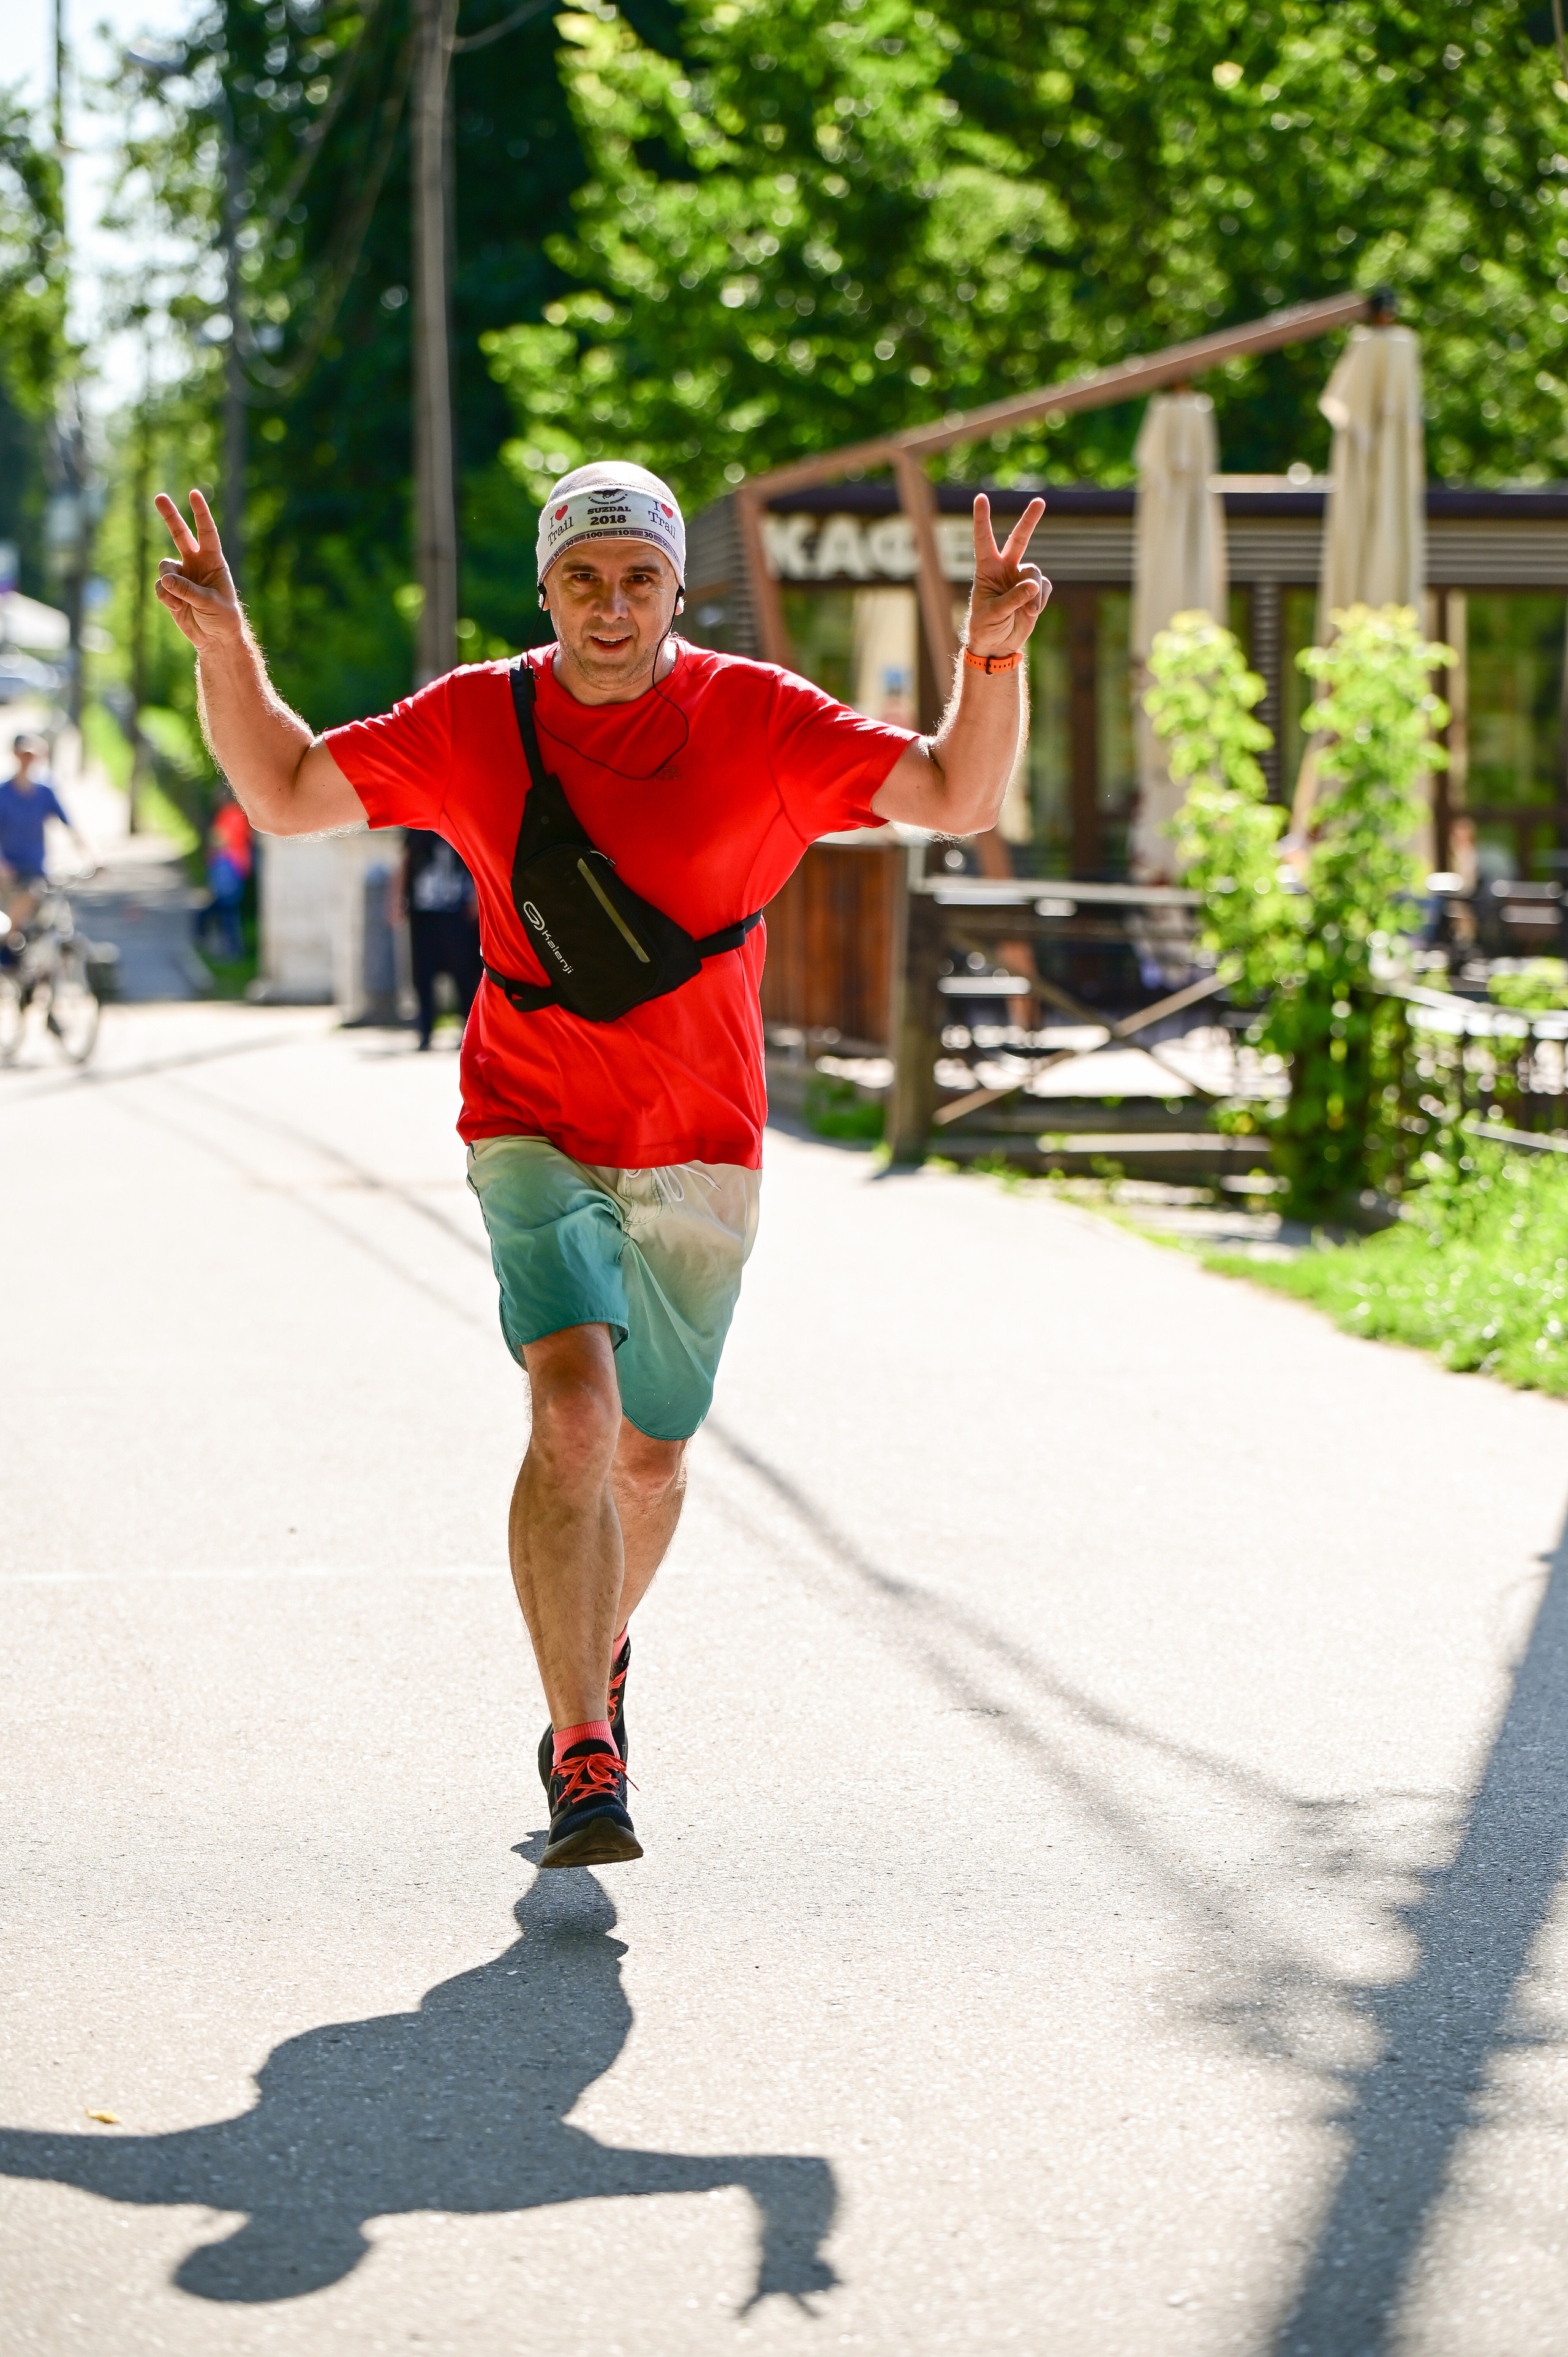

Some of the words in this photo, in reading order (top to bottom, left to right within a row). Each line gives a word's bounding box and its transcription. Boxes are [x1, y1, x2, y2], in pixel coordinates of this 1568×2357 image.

[587, 506, 631, 515] SUZDAL
[652, 500, 660, 512] I
[549, 515, 554, 529] I
[590, 515, 627, 526] 2018
[648, 510, 676, 539] Trail
[548, 516, 574, 547] Trail
[565, 539, 574, 548] 50
[760, 512, 976, 581] КАФЕ
